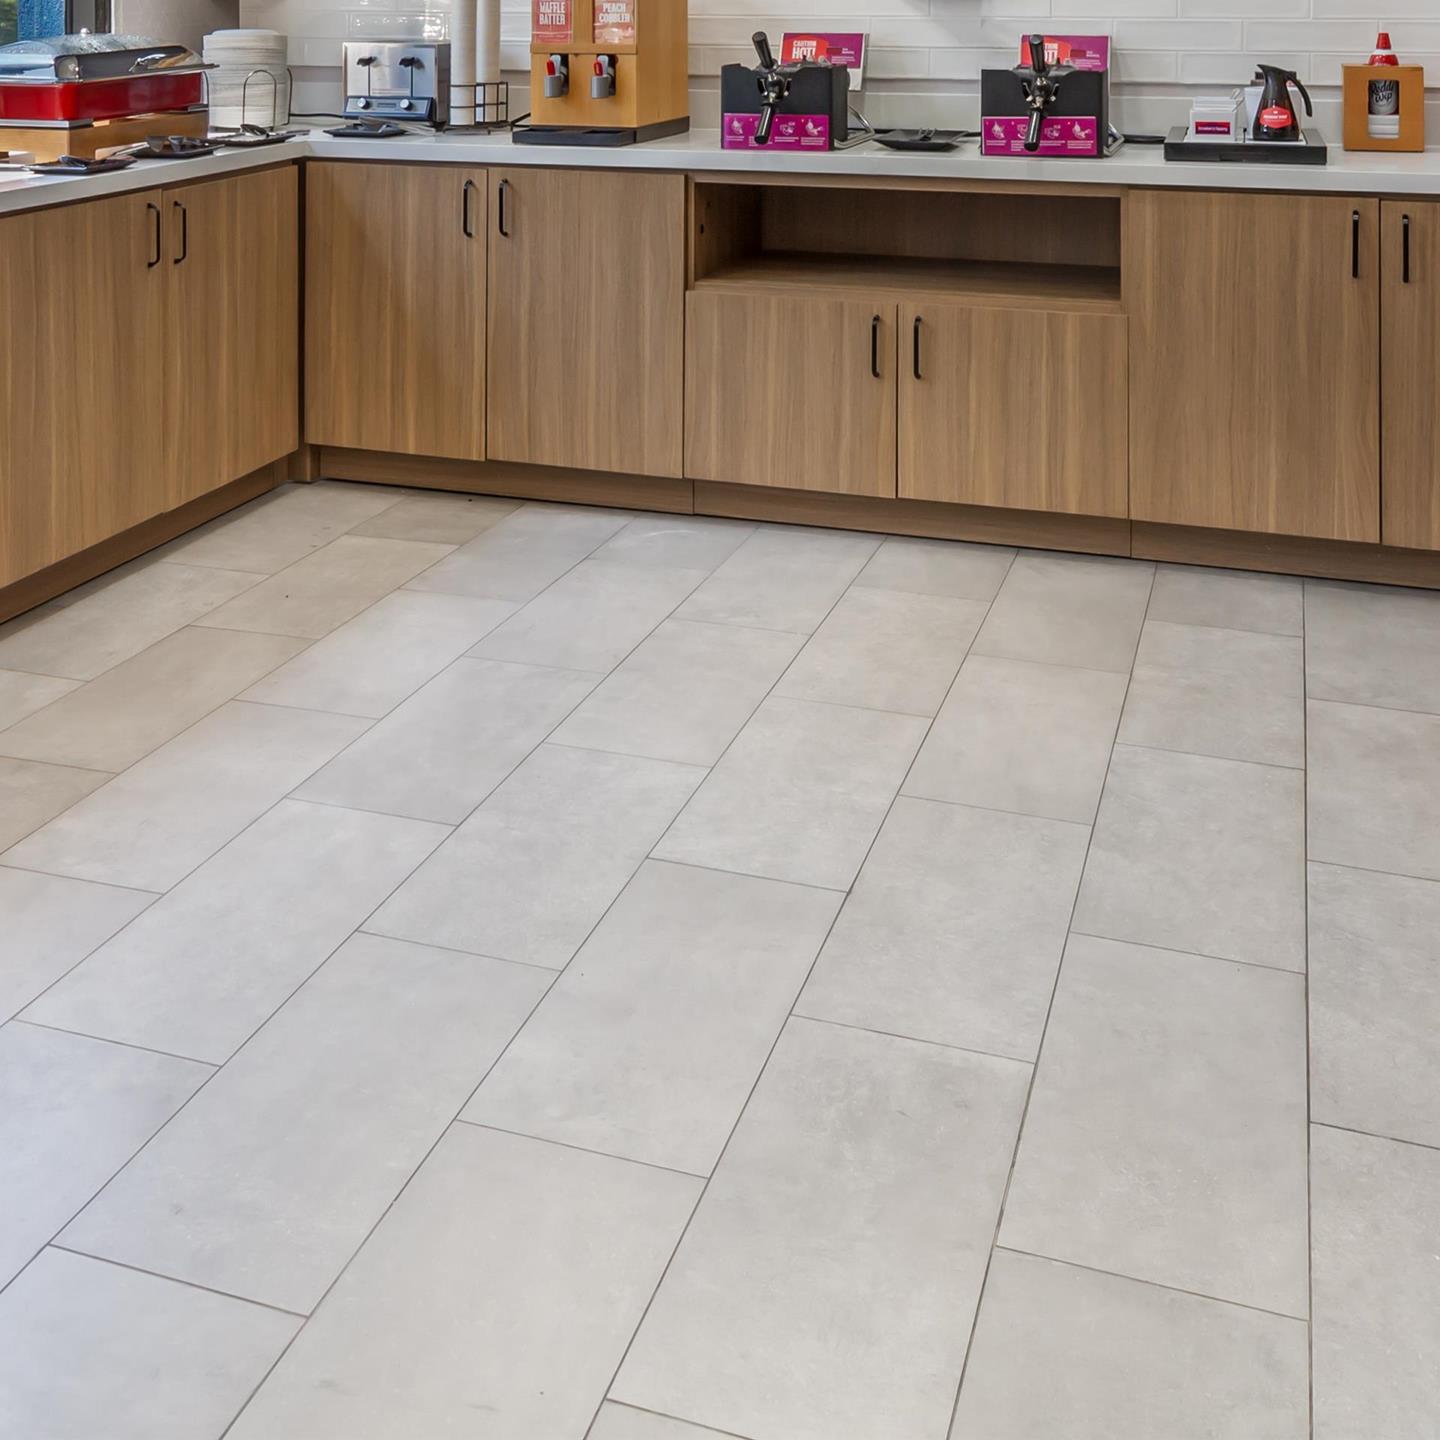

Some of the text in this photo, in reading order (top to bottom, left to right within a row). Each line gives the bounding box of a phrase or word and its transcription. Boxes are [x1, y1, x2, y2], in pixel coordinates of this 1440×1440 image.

[539, 2, 566, 13] WAFFLE
[602, 2, 626, 13] PEACH
[539, 13, 566, 25] BATTER
